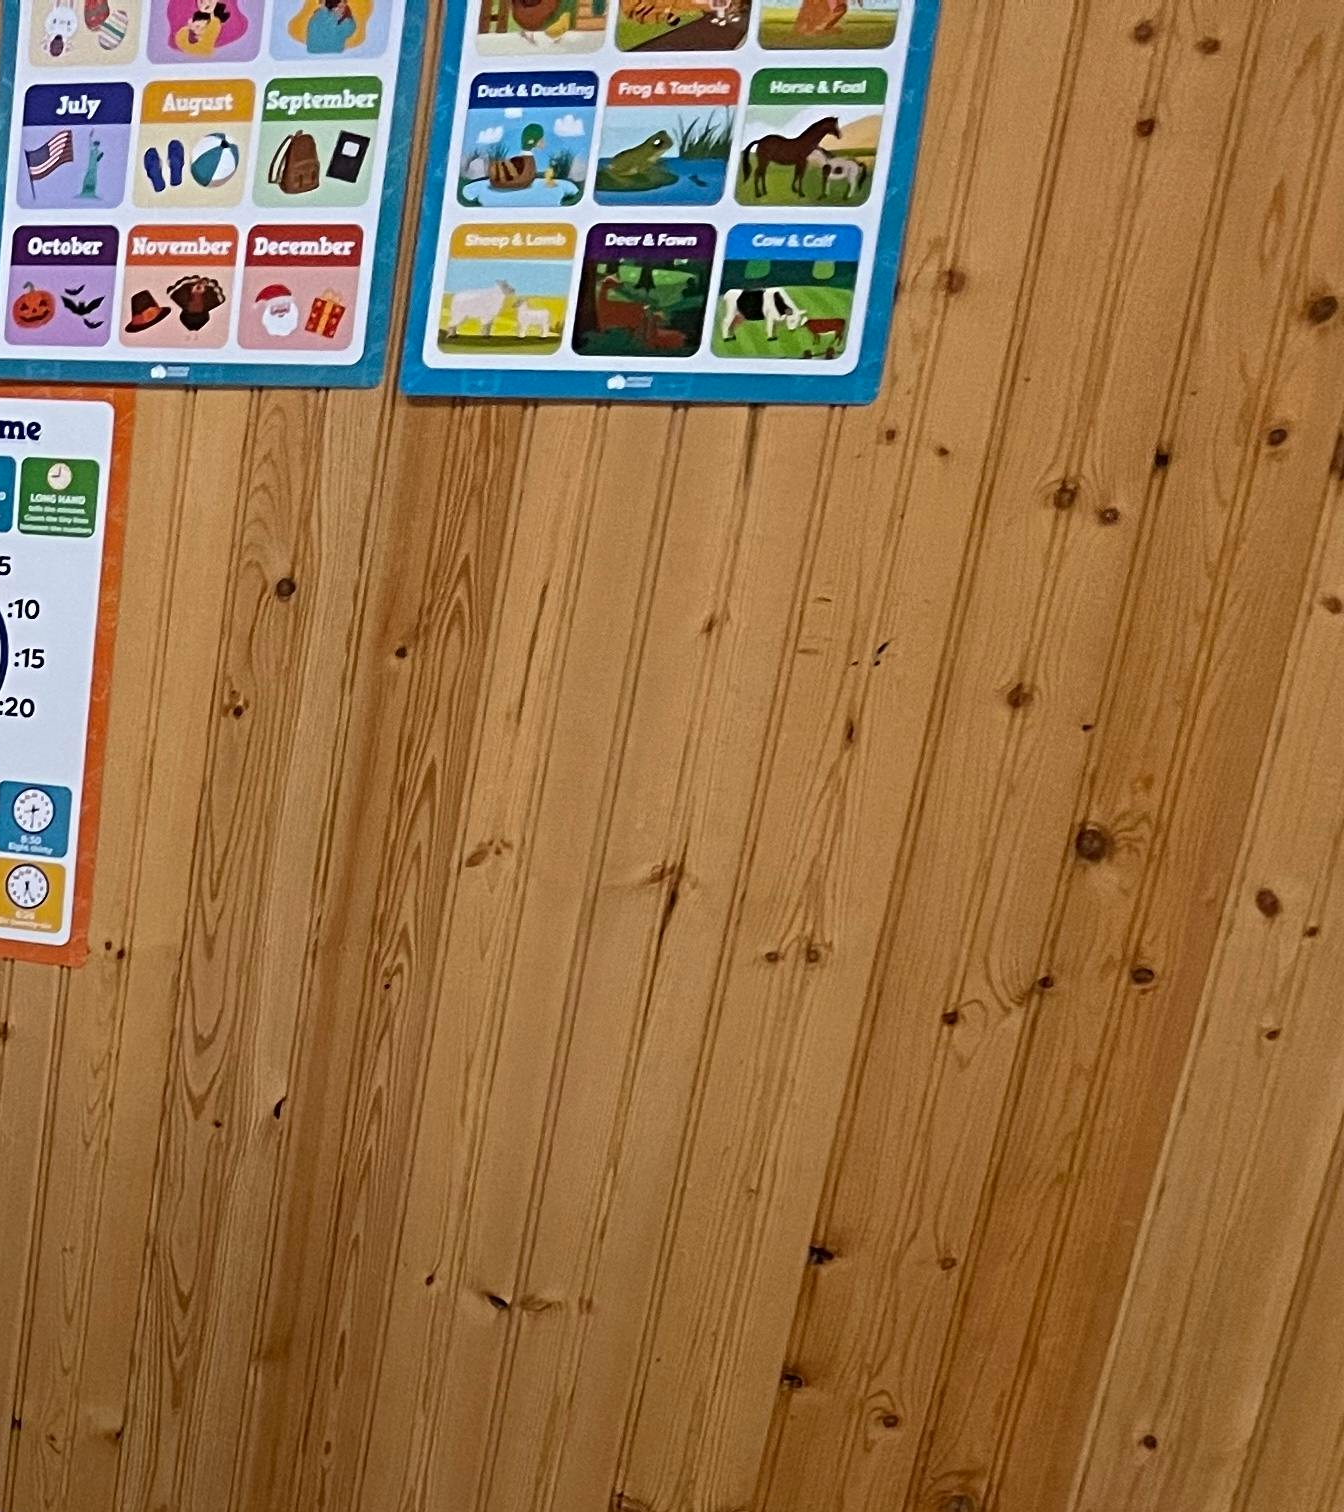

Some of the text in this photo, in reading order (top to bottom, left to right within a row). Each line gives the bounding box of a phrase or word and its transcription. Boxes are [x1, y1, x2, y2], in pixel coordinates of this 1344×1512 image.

[478, 83, 595, 99] Duck & Duckling
[618, 81, 731, 98] Frog & Tadpole
[770, 80, 867, 94] Horse & Foal
[56, 95, 101, 119] July
[162, 93, 233, 116] August
[266, 90, 378, 115] September
[27, 236, 103, 256] October
[132, 236, 232, 257] November
[253, 236, 355, 257] December
[465, 233, 566, 249] Sheep & Lamb
[605, 233, 697, 247] Deer & Fawn
[752, 233, 837, 247] Cow & Calf
[7, 599, 40, 620] :10
[13, 648, 45, 669] :15
